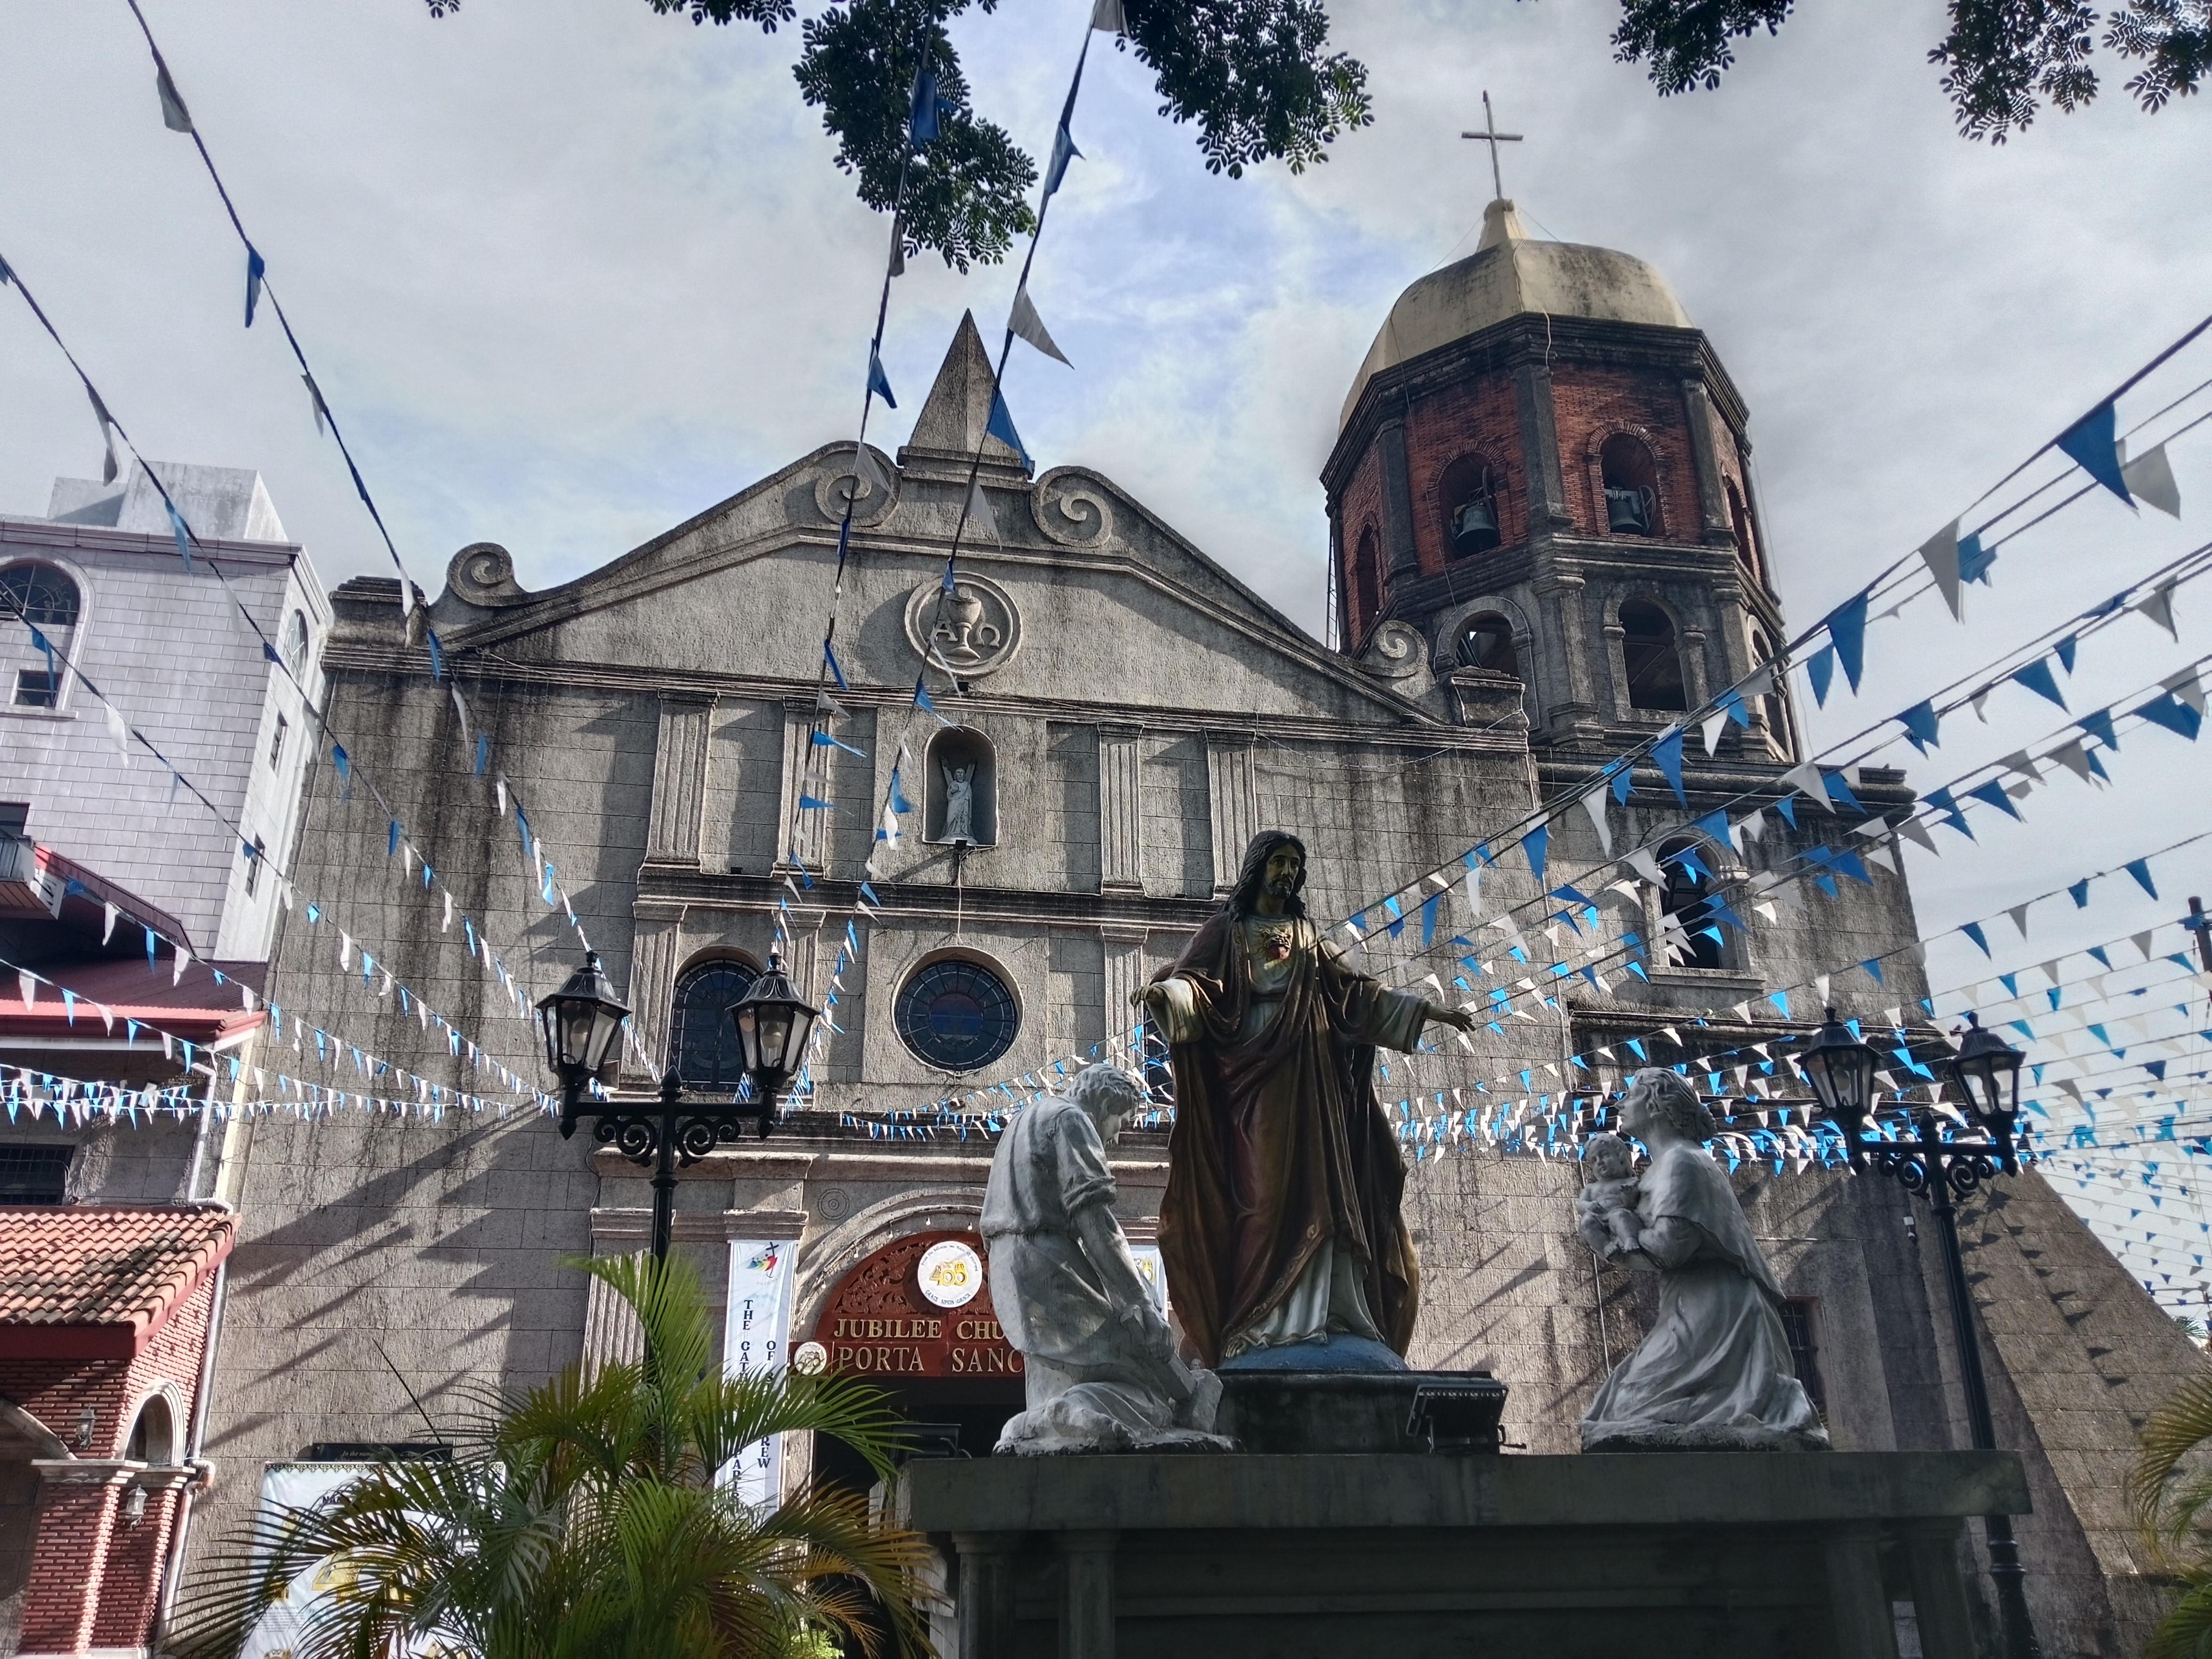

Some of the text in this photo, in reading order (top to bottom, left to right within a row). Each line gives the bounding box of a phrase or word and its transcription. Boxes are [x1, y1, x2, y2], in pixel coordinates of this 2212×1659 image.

[743, 1300, 754, 1330] THE
[834, 1318, 1006, 1340] JUBILEE CHU
[766, 1340, 776, 1361] OF
[838, 1346, 1024, 1373] PORTA SANC
